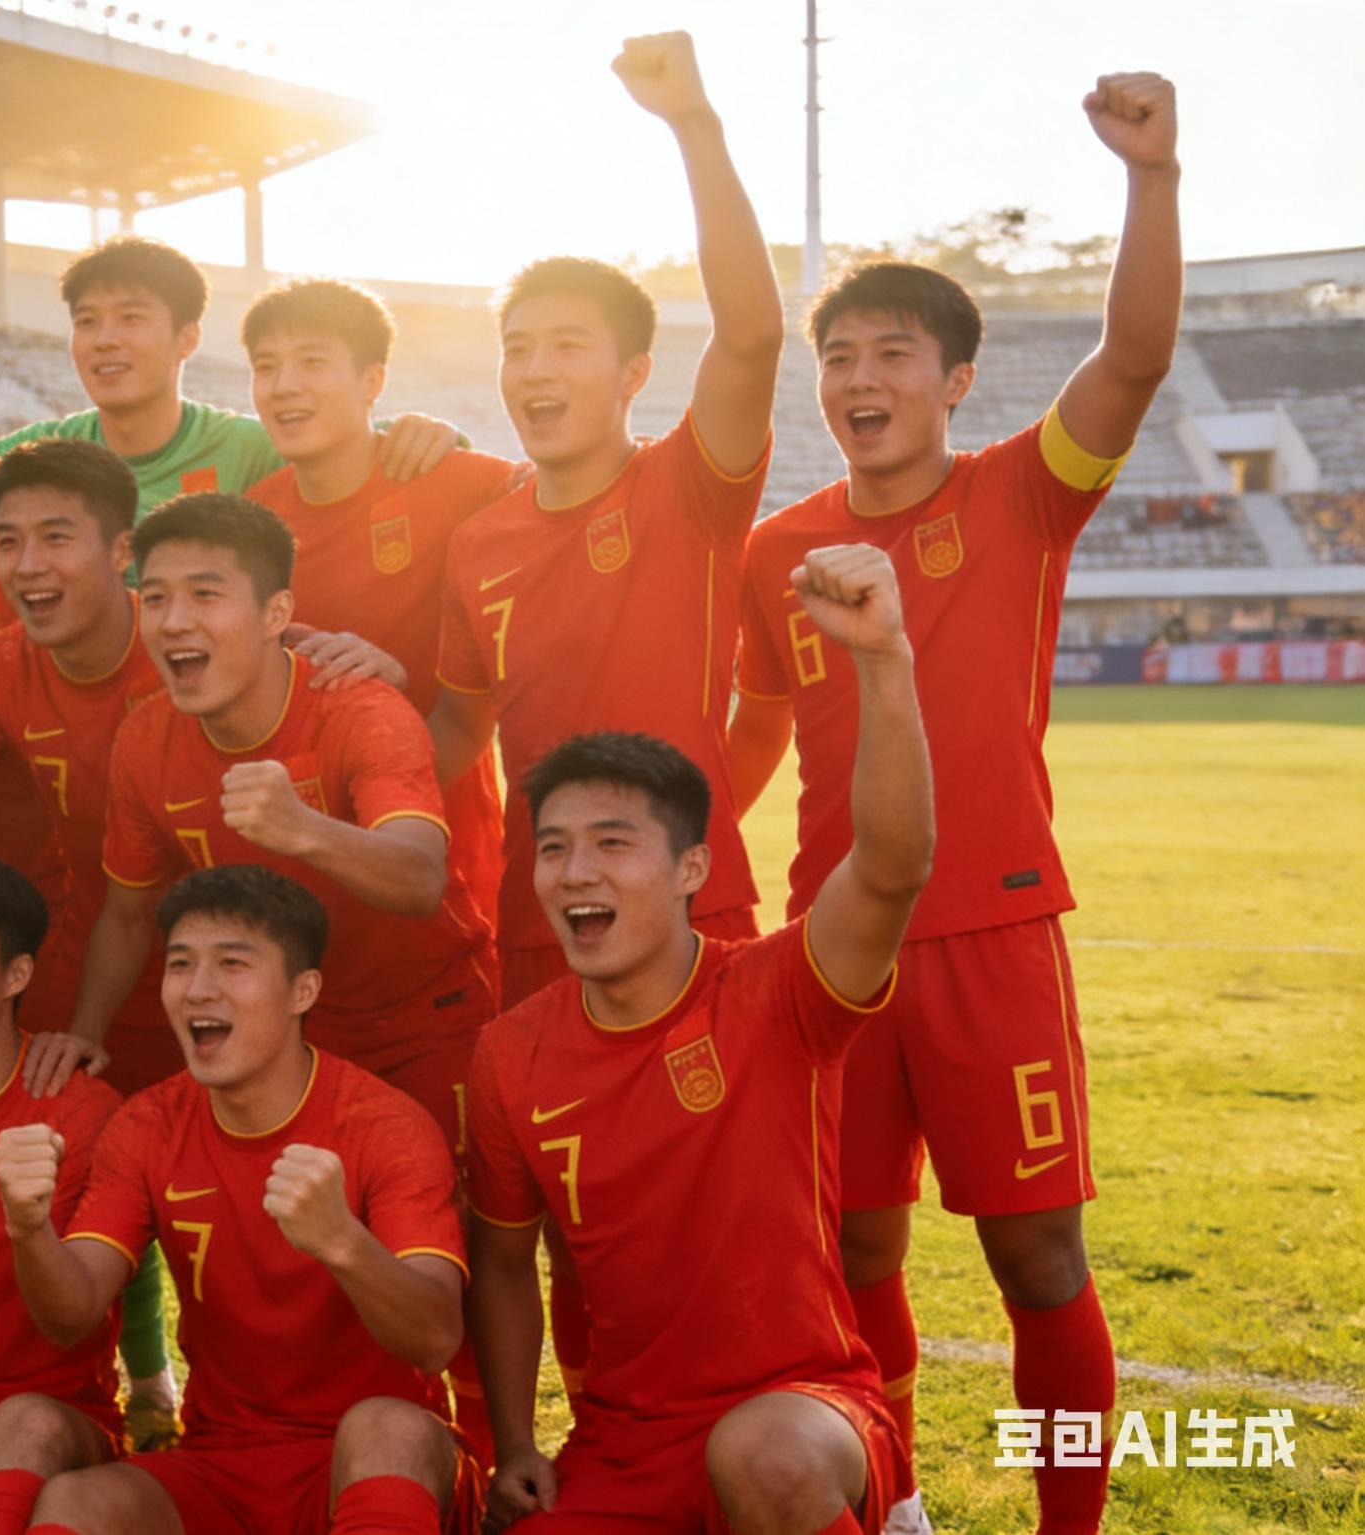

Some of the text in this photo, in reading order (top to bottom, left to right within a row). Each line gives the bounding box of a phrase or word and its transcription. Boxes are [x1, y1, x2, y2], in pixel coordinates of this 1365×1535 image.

[480, 597, 512, 681] 7
[786, 608, 826, 687] 6
[32, 757, 69, 817] 7
[1013, 1060, 1060, 1150] 6
[537, 1135, 579, 1225] 7
[171, 1220, 212, 1303] 7
